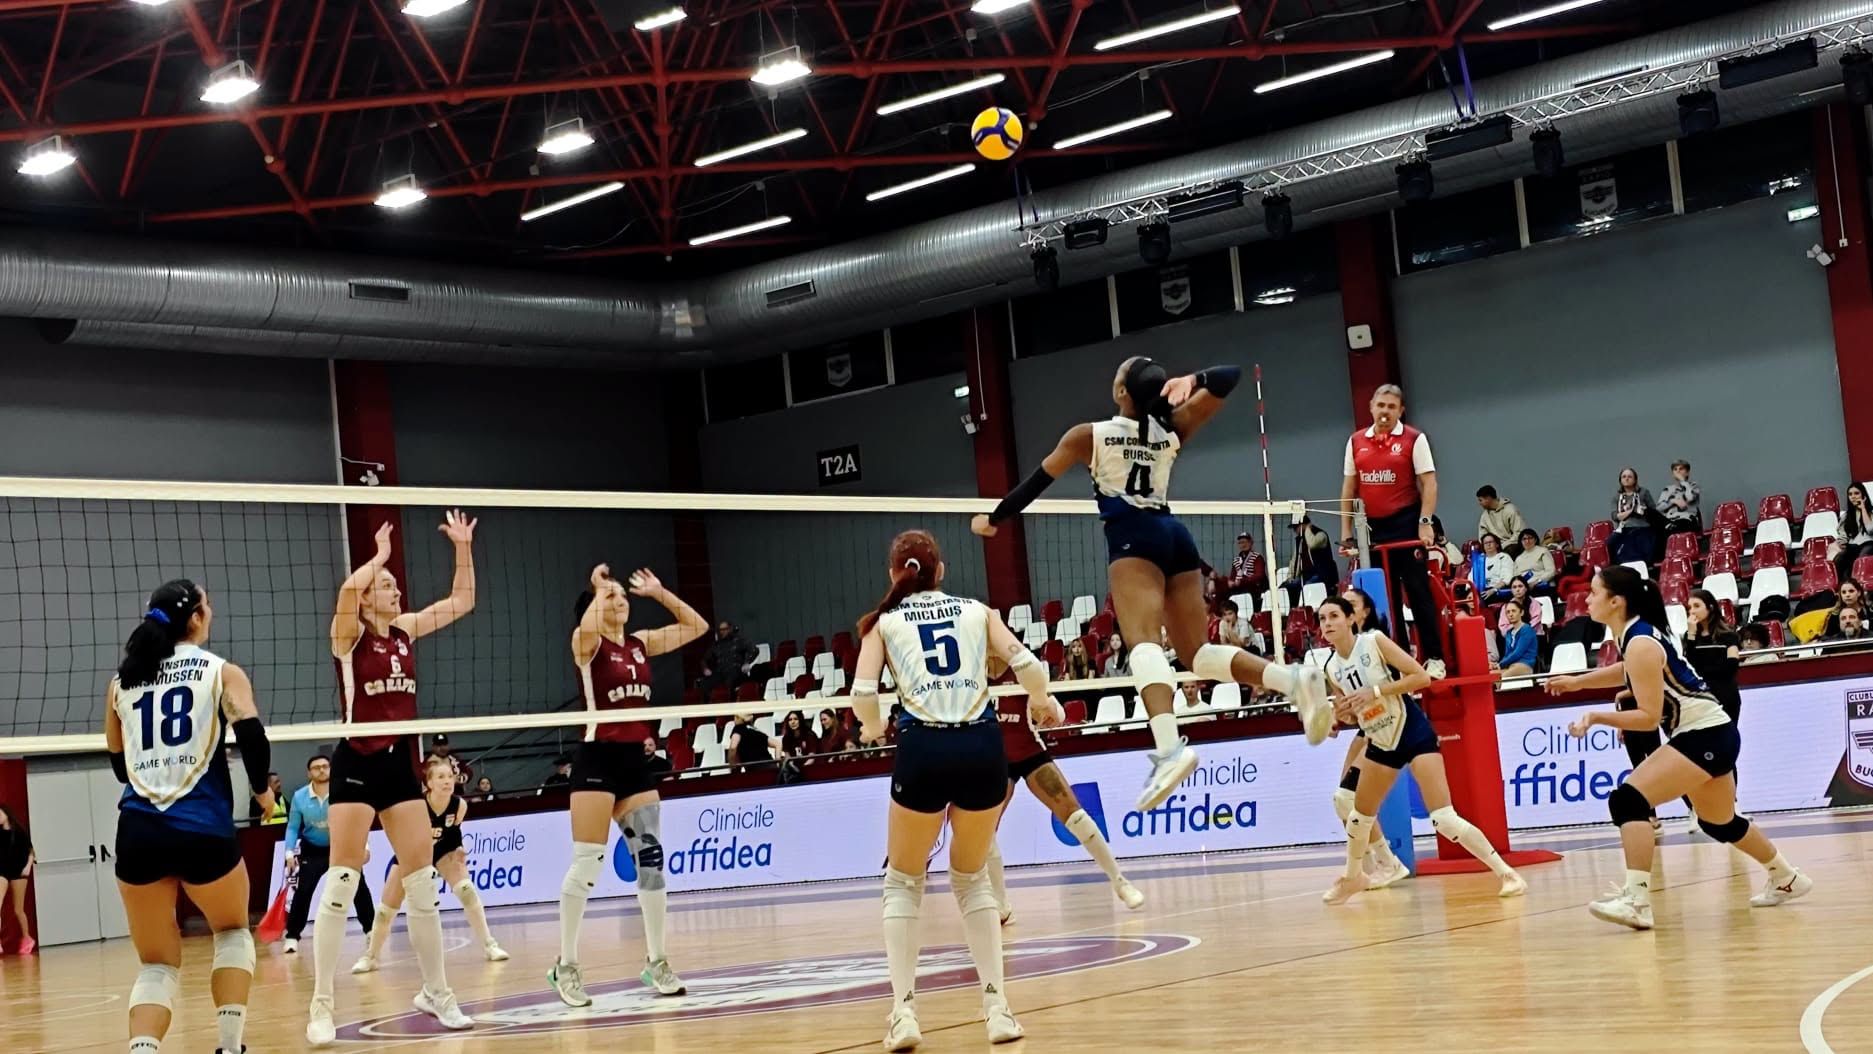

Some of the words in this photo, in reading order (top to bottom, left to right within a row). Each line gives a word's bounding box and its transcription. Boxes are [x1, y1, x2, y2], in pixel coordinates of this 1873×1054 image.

[1104, 436, 1125, 447] CSM
[820, 453, 858, 478] T2A
[1359, 469, 1396, 484] TradeVille
[1124, 461, 1155, 498] 4
[917, 620, 961, 677] 5
[158, 657, 210, 671] NSTANTA
[390, 654, 401, 674] 6
[625, 664, 637, 680] 7
[911, 680, 943, 697] GAME
[1346, 669, 1363, 690] 11
[132, 685, 194, 751] 18
[1522, 724, 1622, 757] Clinici
[133, 758, 160, 772] GAME
[162, 755, 197, 767] WORLD
[1509, 759, 1635, 807] ffide
[698, 804, 774, 833] Clinicile
[668, 836, 773, 875] affidea
